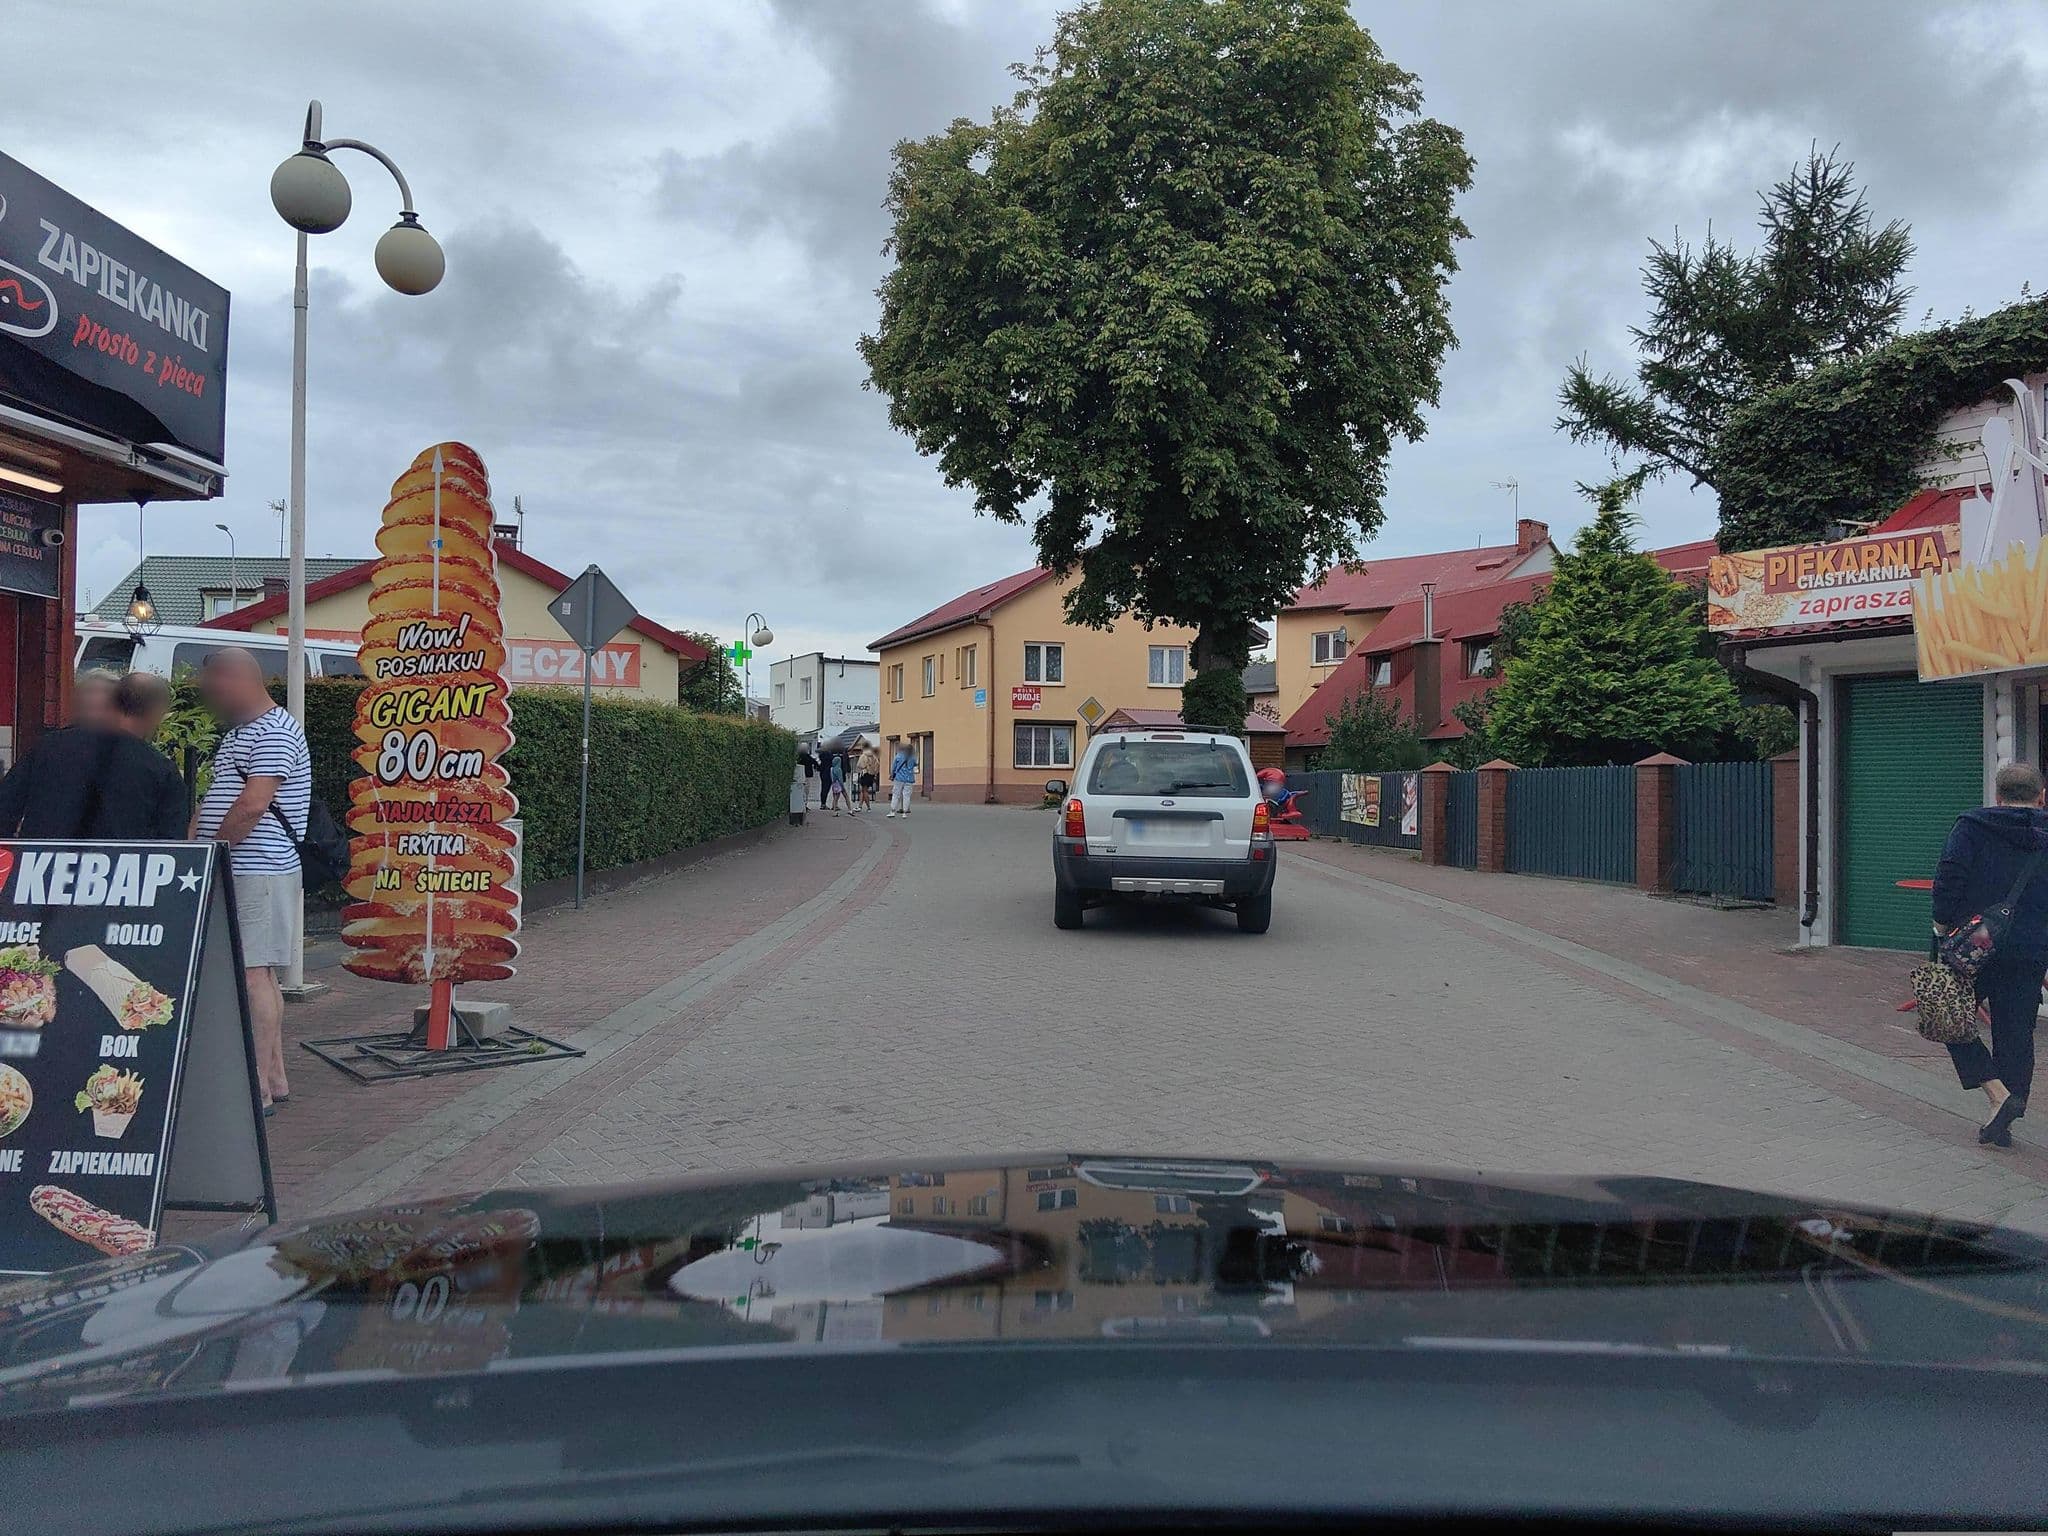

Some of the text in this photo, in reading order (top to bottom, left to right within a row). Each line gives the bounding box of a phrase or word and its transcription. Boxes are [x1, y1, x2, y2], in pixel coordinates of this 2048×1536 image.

[38, 218, 209, 352] ZAPIEKANKI
[73, 314, 205, 397] prosto z pieca
[1768, 537, 1942, 587] PIEKARNIA
[1797, 564, 1912, 590] CIASTKARNIA
[1799, 590, 1912, 618] zaprasza
[397, 613, 472, 653] Wow!
[377, 650, 485, 678] POSMAKUJ
[371, 683, 496, 729] GIGANT
[376, 728, 484, 785] 80 cm
[376, 796, 492, 823] NAJDŁUŻSZA
[397, 834, 465, 856] FRYTKA
[14, 851, 176, 907] KEBAP
[375, 866, 492, 892] NA ŚWIECIE
[106, 923, 164, 946] ROLLO
[100, 1035, 140, 1057] BOX
[48, 1150, 154, 1176] ZAPIEKANKI
